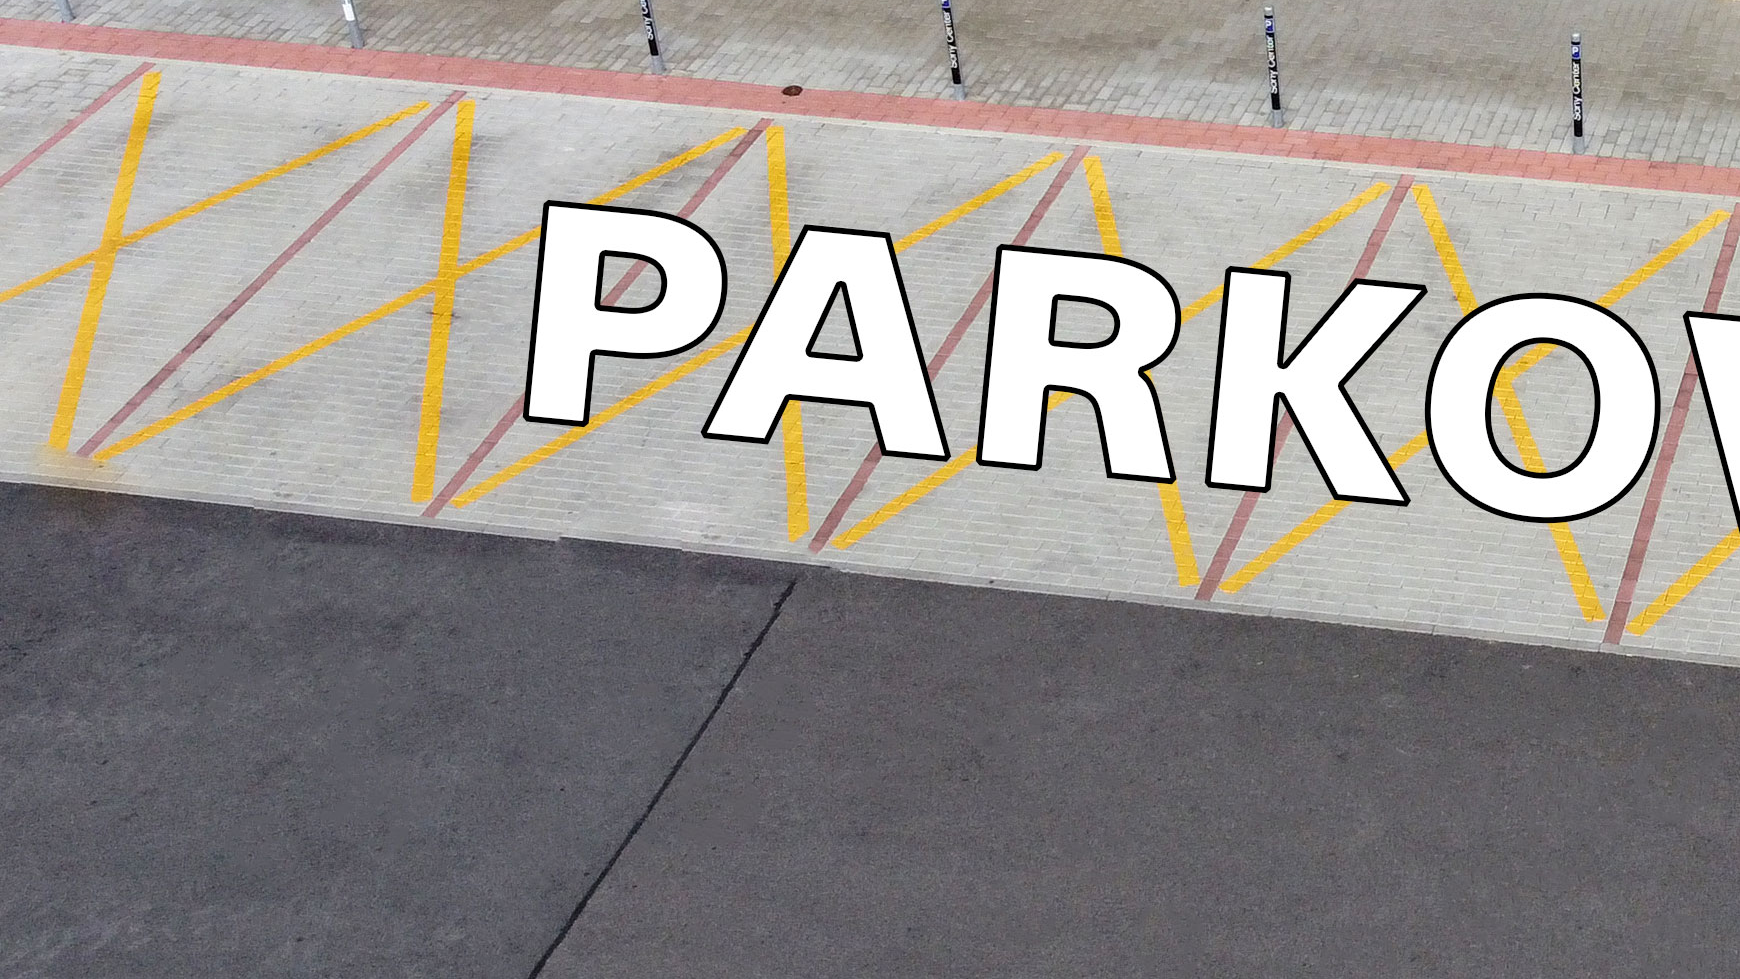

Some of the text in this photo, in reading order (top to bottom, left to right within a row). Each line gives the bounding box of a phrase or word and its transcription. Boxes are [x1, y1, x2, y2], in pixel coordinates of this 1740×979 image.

[1572, 46, 1579, 55] P
[1572, 61, 1583, 121] Sony Center
